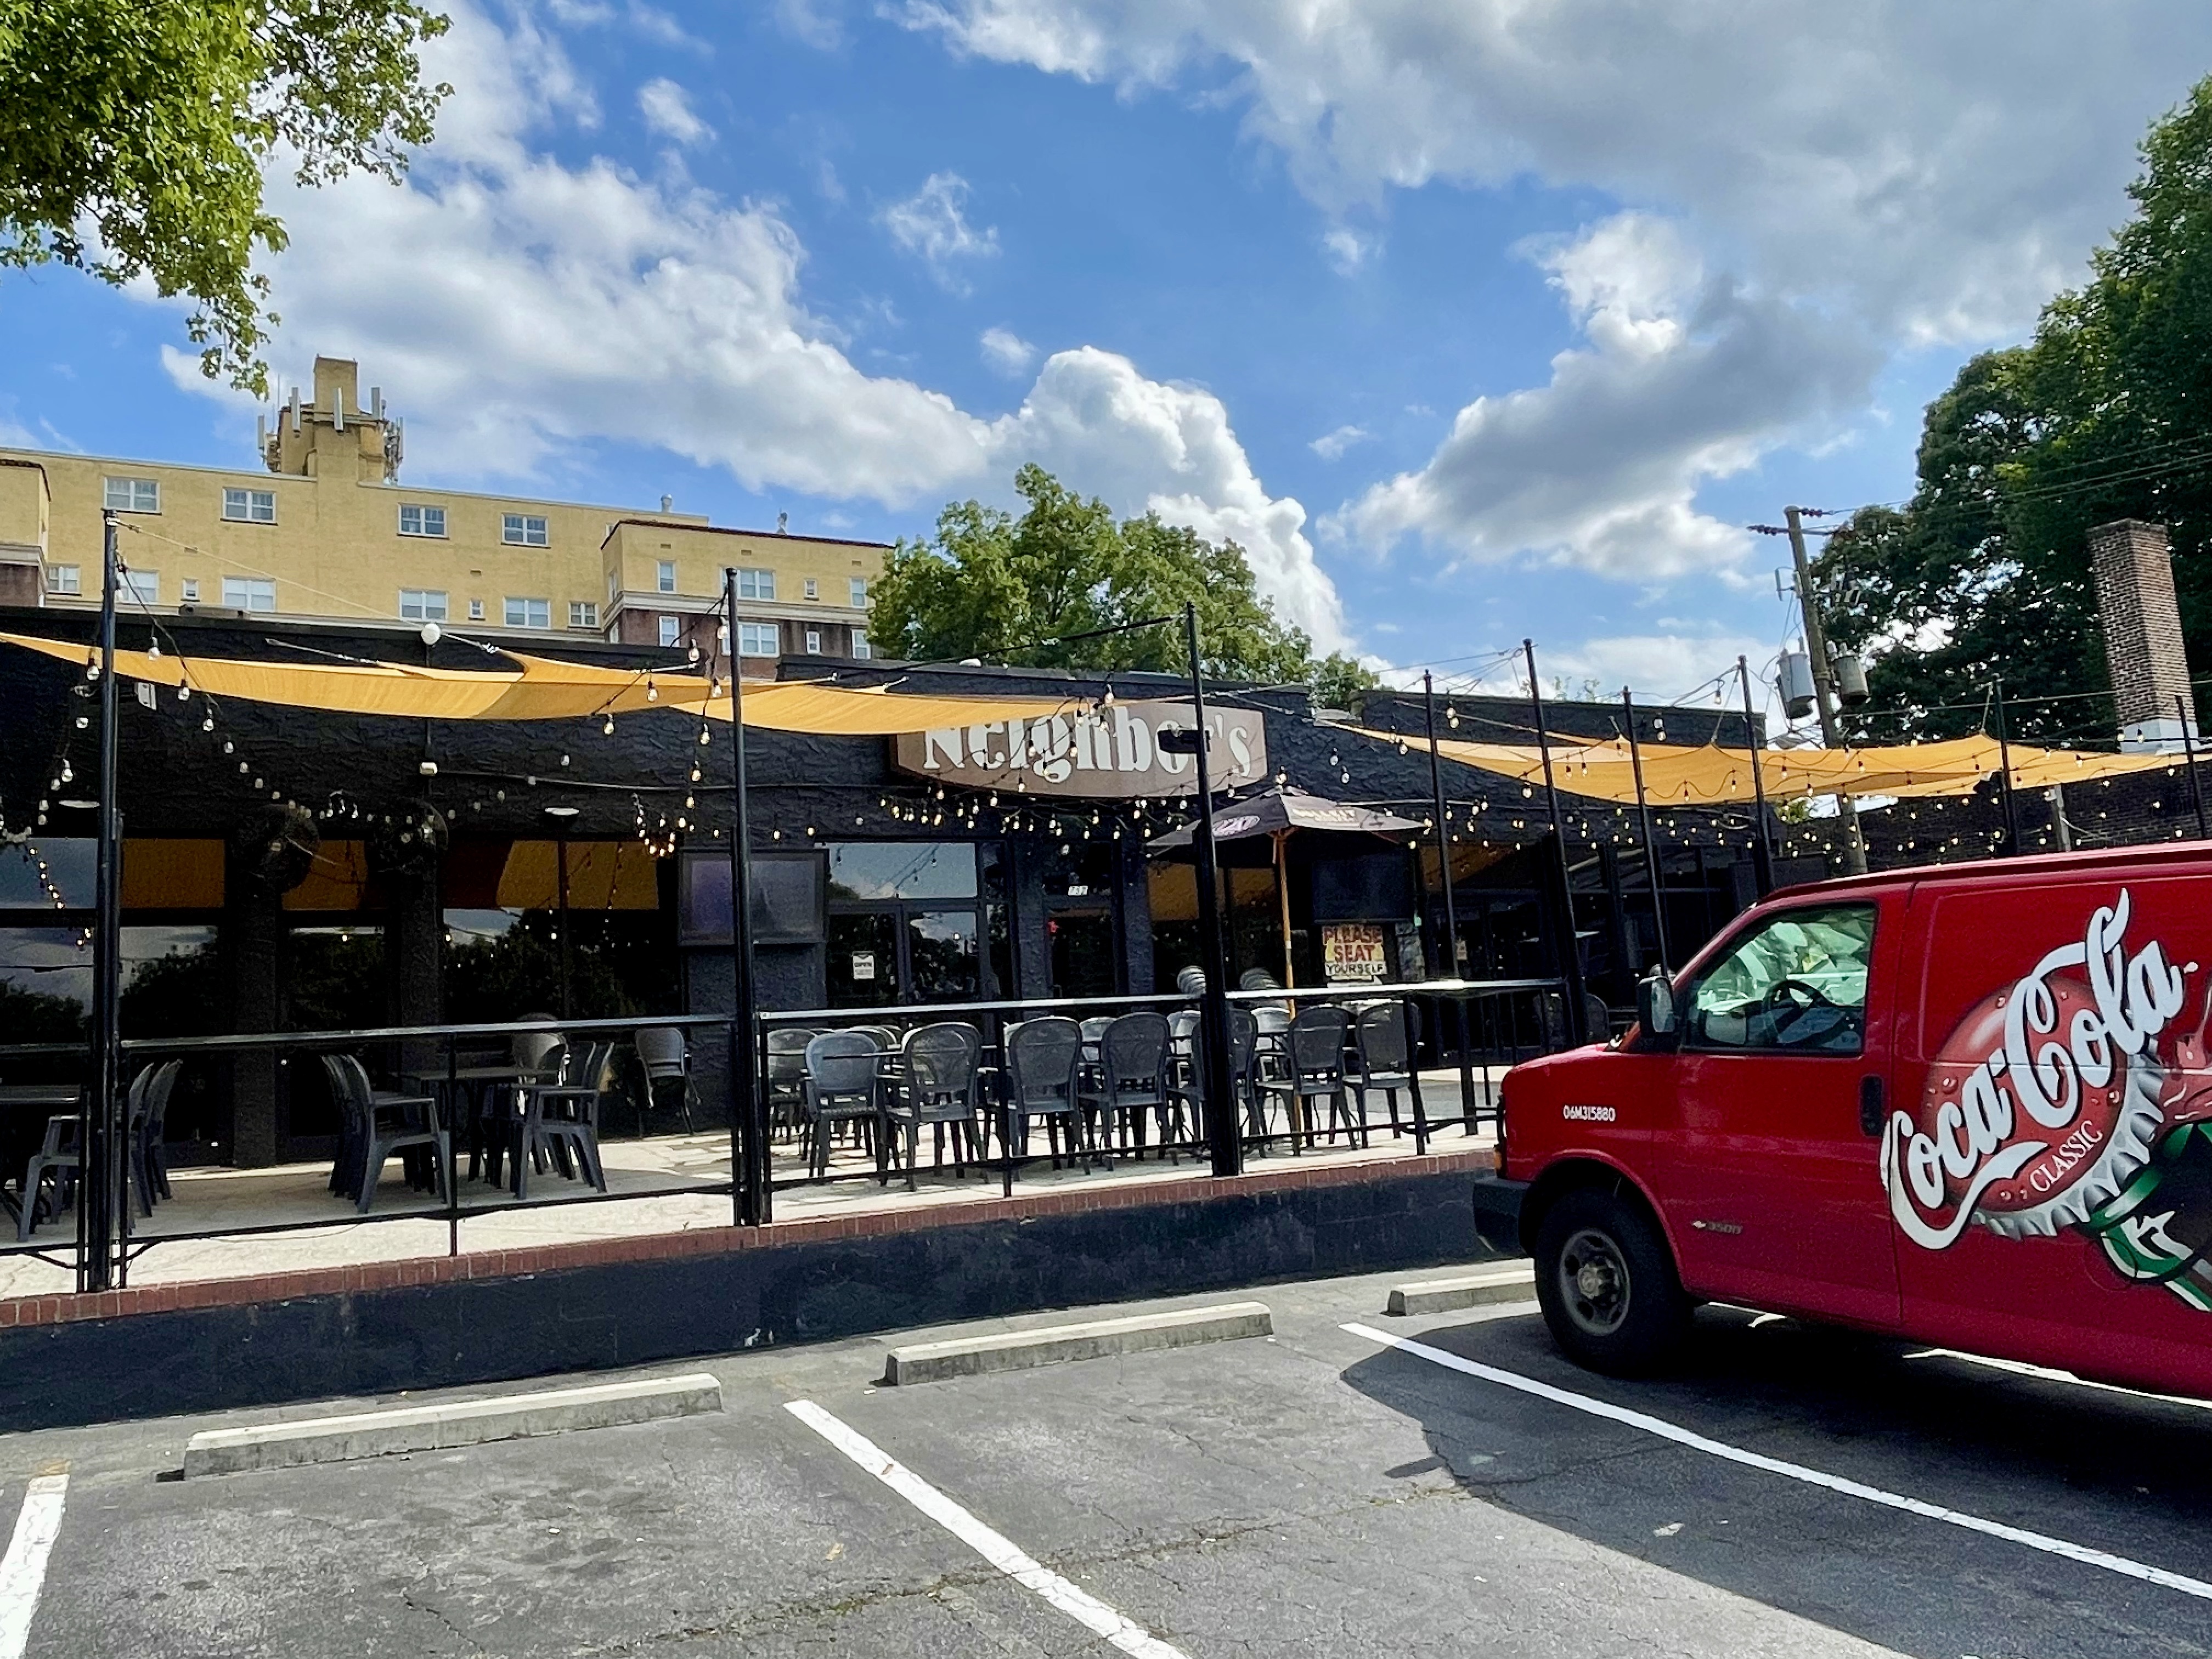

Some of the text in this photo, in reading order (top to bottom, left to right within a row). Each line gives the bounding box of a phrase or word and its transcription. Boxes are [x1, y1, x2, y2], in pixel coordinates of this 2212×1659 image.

[1323, 927, 1383, 943] PLEASE
[1333, 945, 1376, 962] SEAT
[1325, 963, 1384, 974] YOURSELF
[2030, 1119, 2103, 1192] CLASSIC
